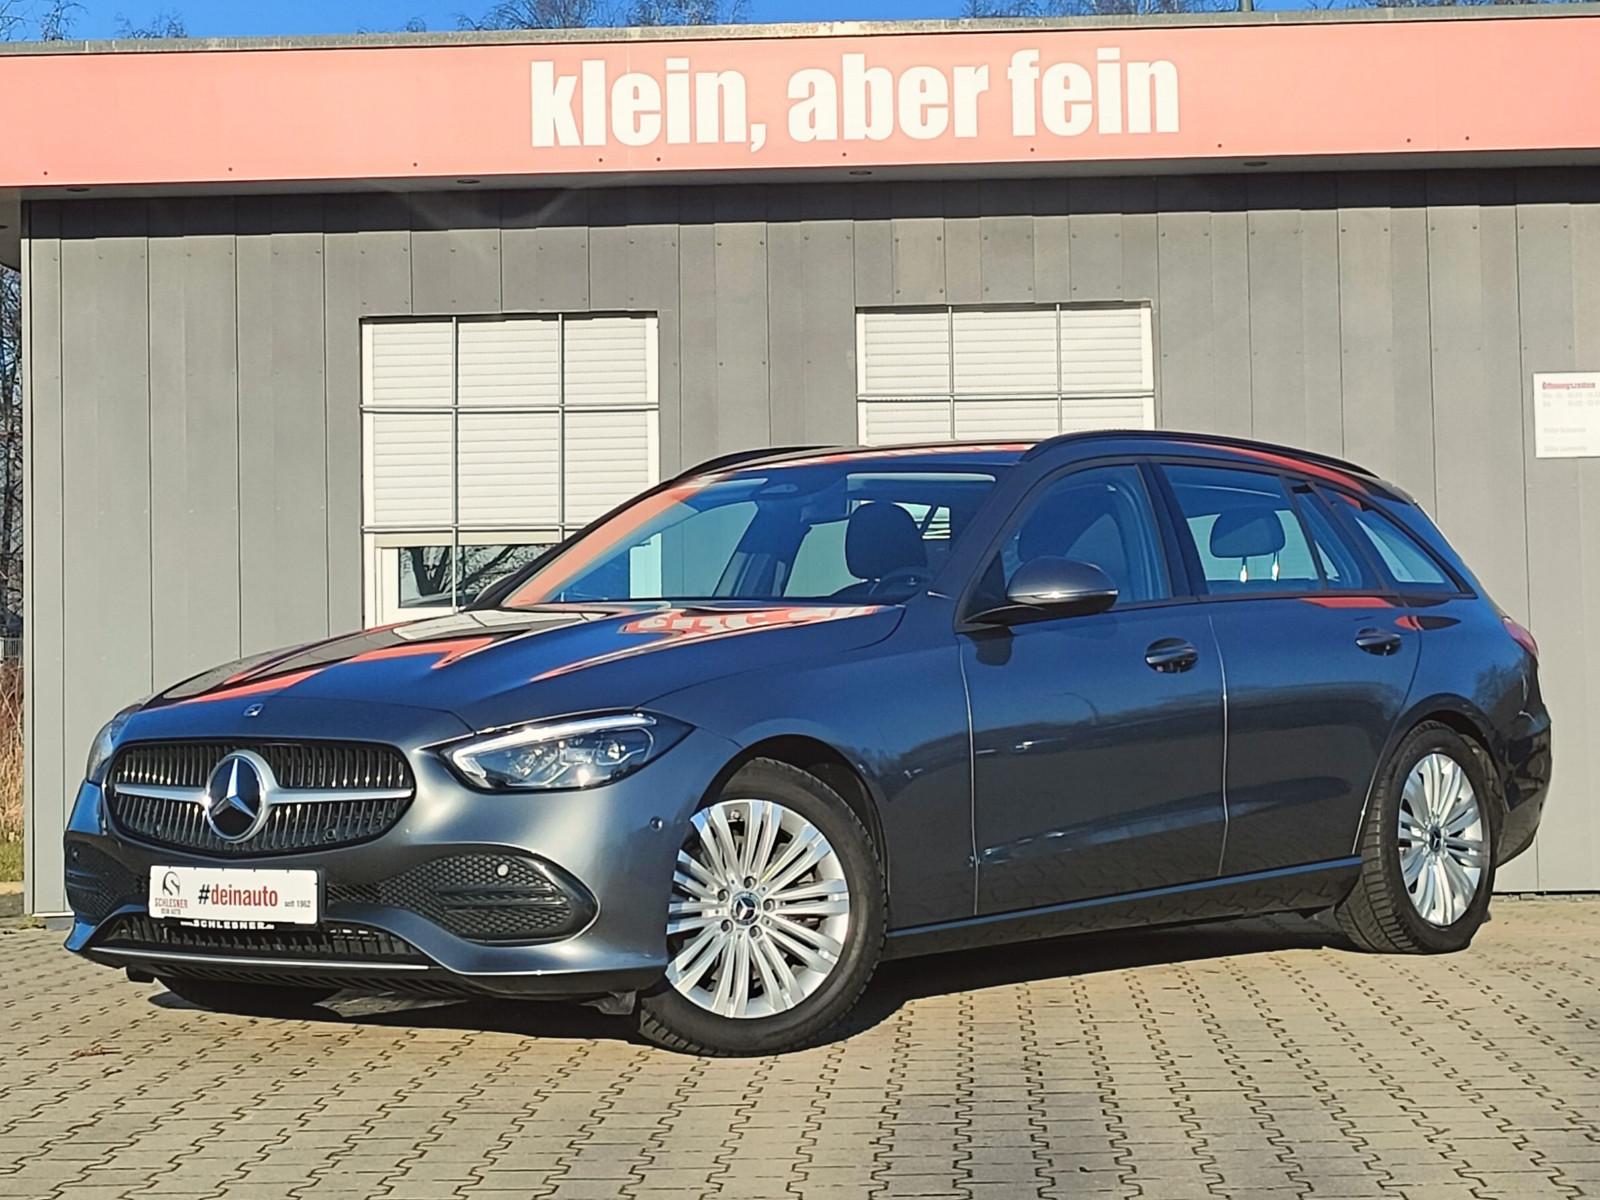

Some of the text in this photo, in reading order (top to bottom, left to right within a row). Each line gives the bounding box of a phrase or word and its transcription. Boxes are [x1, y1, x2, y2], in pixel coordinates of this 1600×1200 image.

[530, 47, 1180, 153] klein, aber fein
[198, 884, 278, 907] #deinauto
